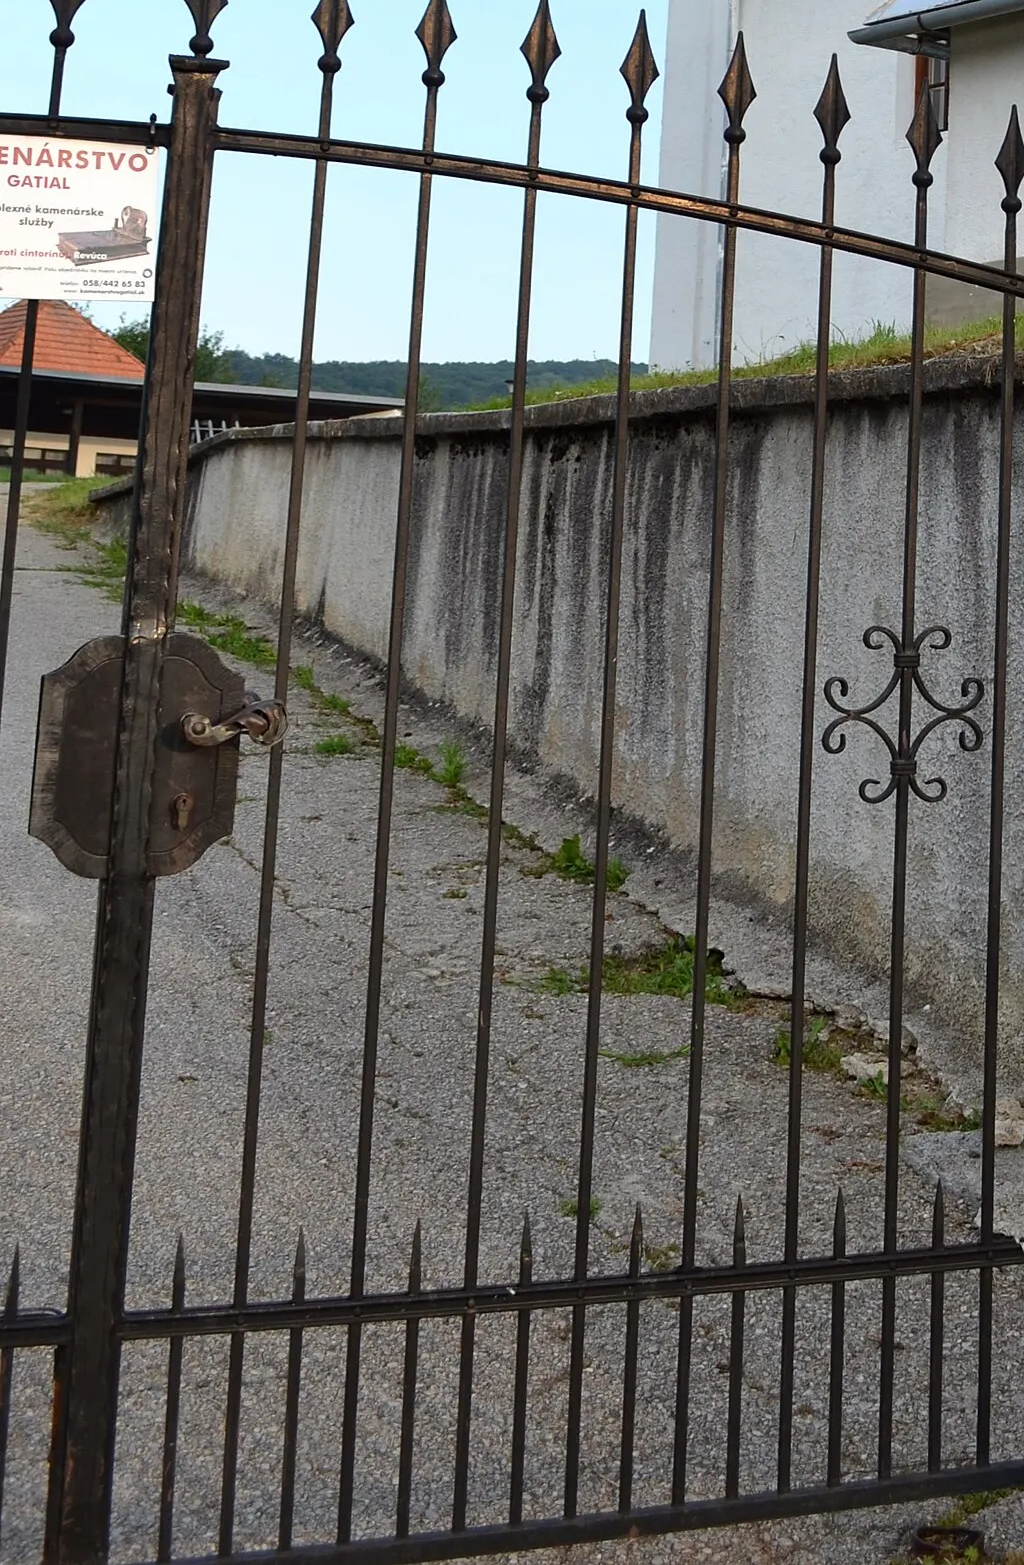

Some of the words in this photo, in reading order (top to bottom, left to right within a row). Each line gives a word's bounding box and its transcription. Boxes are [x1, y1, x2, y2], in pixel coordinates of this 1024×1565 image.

[7, 175, 70, 189] GATIAL
[35, 205, 104, 217] kamenárske
[19, 217, 54, 229] služby
[73, 251, 107, 260] Revúca
[83, 279, 119, 288] 058/442
